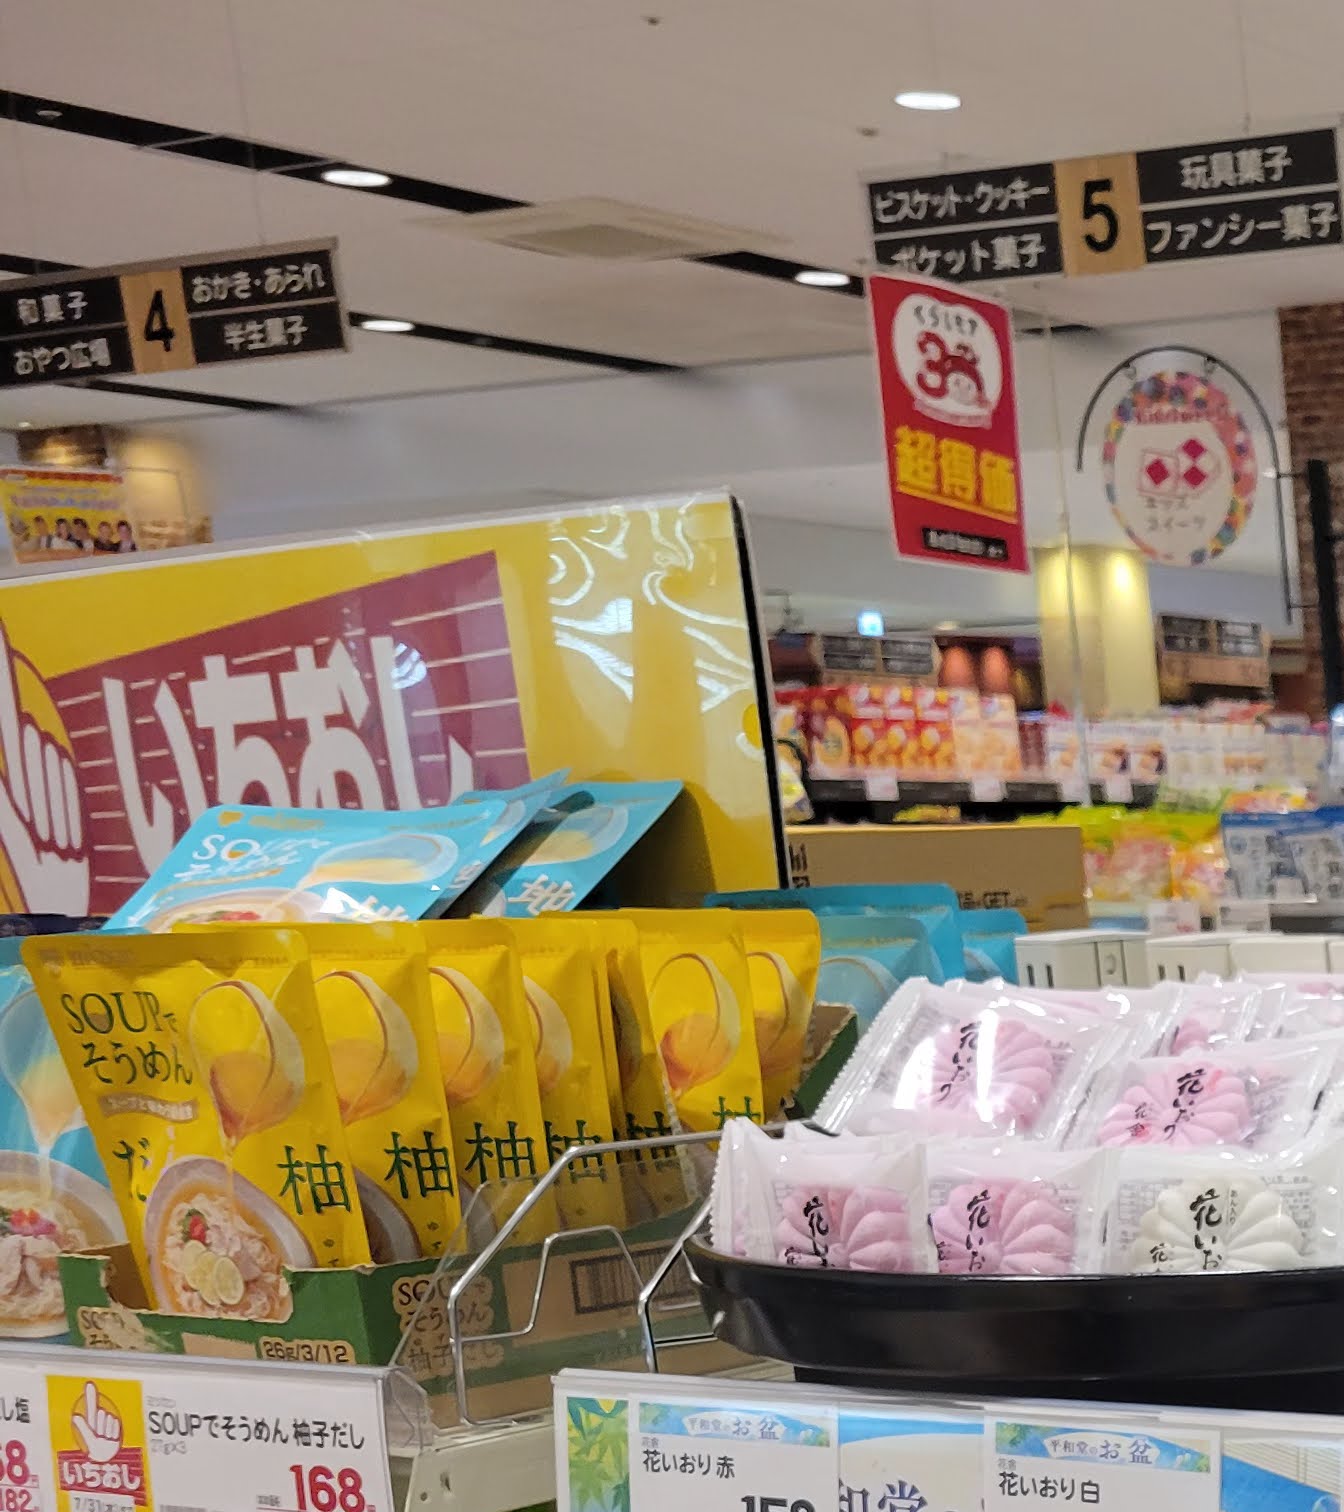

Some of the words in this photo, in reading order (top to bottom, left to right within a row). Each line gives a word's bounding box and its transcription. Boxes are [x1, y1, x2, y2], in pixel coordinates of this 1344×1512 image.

[1180, 146, 1291, 189] 玩具菓子
[875, 182, 1049, 223] ビスケット・クッキー
[1082, 180, 1119, 252] 5
[1146, 204, 1338, 254] ファンシー菓子
[191, 262, 326, 304] おかき・あられ
[18, 291, 88, 324] 和菓子
[145, 289, 174, 354] 4
[224, 314, 309, 350] 半生菓子
[14, 338, 111, 376] おやつ広場
[103, 635, 475, 876] いちおし
[61, 991, 177, 1035] SOUPで
[83, 1041, 193, 1085] そうめん
[385, 1130, 454, 1199] 柚
[465, 1120, 537, 1184] 柚
[277, 1144, 353, 1215] 柚
[148, 1411, 289, 1444] SOUPでそうめん
[293, 1420, 365, 1450] 柚子だし
[1049, 1437, 1153, 1465] 平和堂のお盆
[62, 1461, 140, 1491] いちおし
